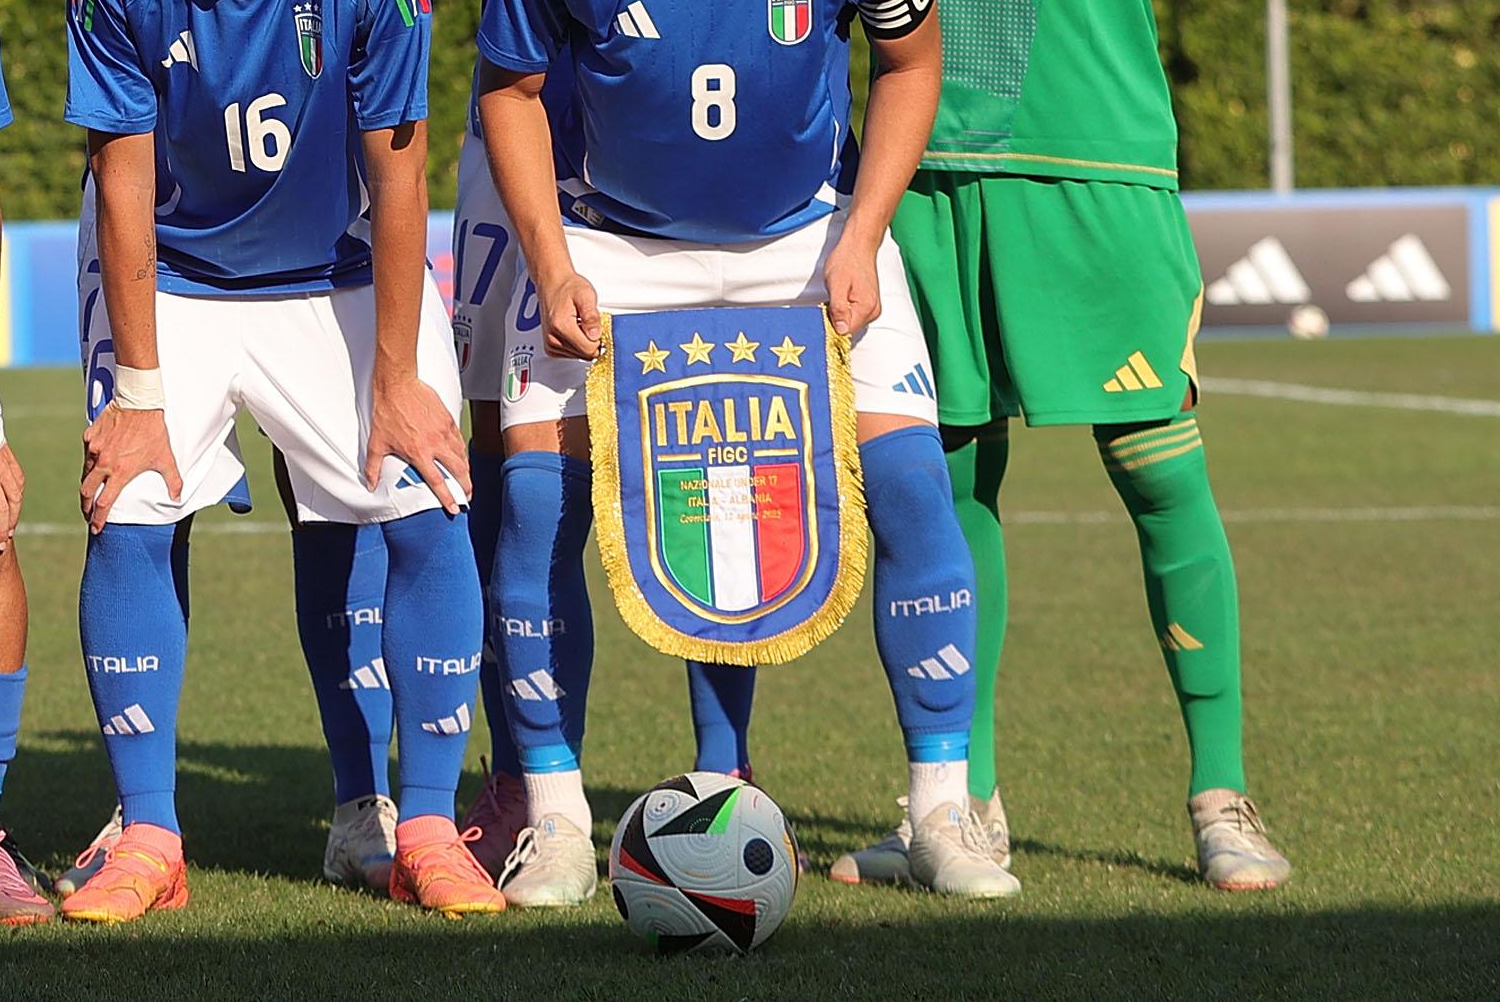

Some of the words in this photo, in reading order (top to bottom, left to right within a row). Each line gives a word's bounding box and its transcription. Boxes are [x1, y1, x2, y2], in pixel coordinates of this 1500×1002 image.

[690, 63, 737, 141] 8
[224, 92, 292, 173] 16
[455, 219, 509, 305] 17
[654, 396, 797, 447] ITALIA
[708, 446, 748, 465] FIGC
[326, 607, 383, 629] ITAL
[891, 589, 972, 617] ITALIA
[417, 651, 481, 676] ITALIA
